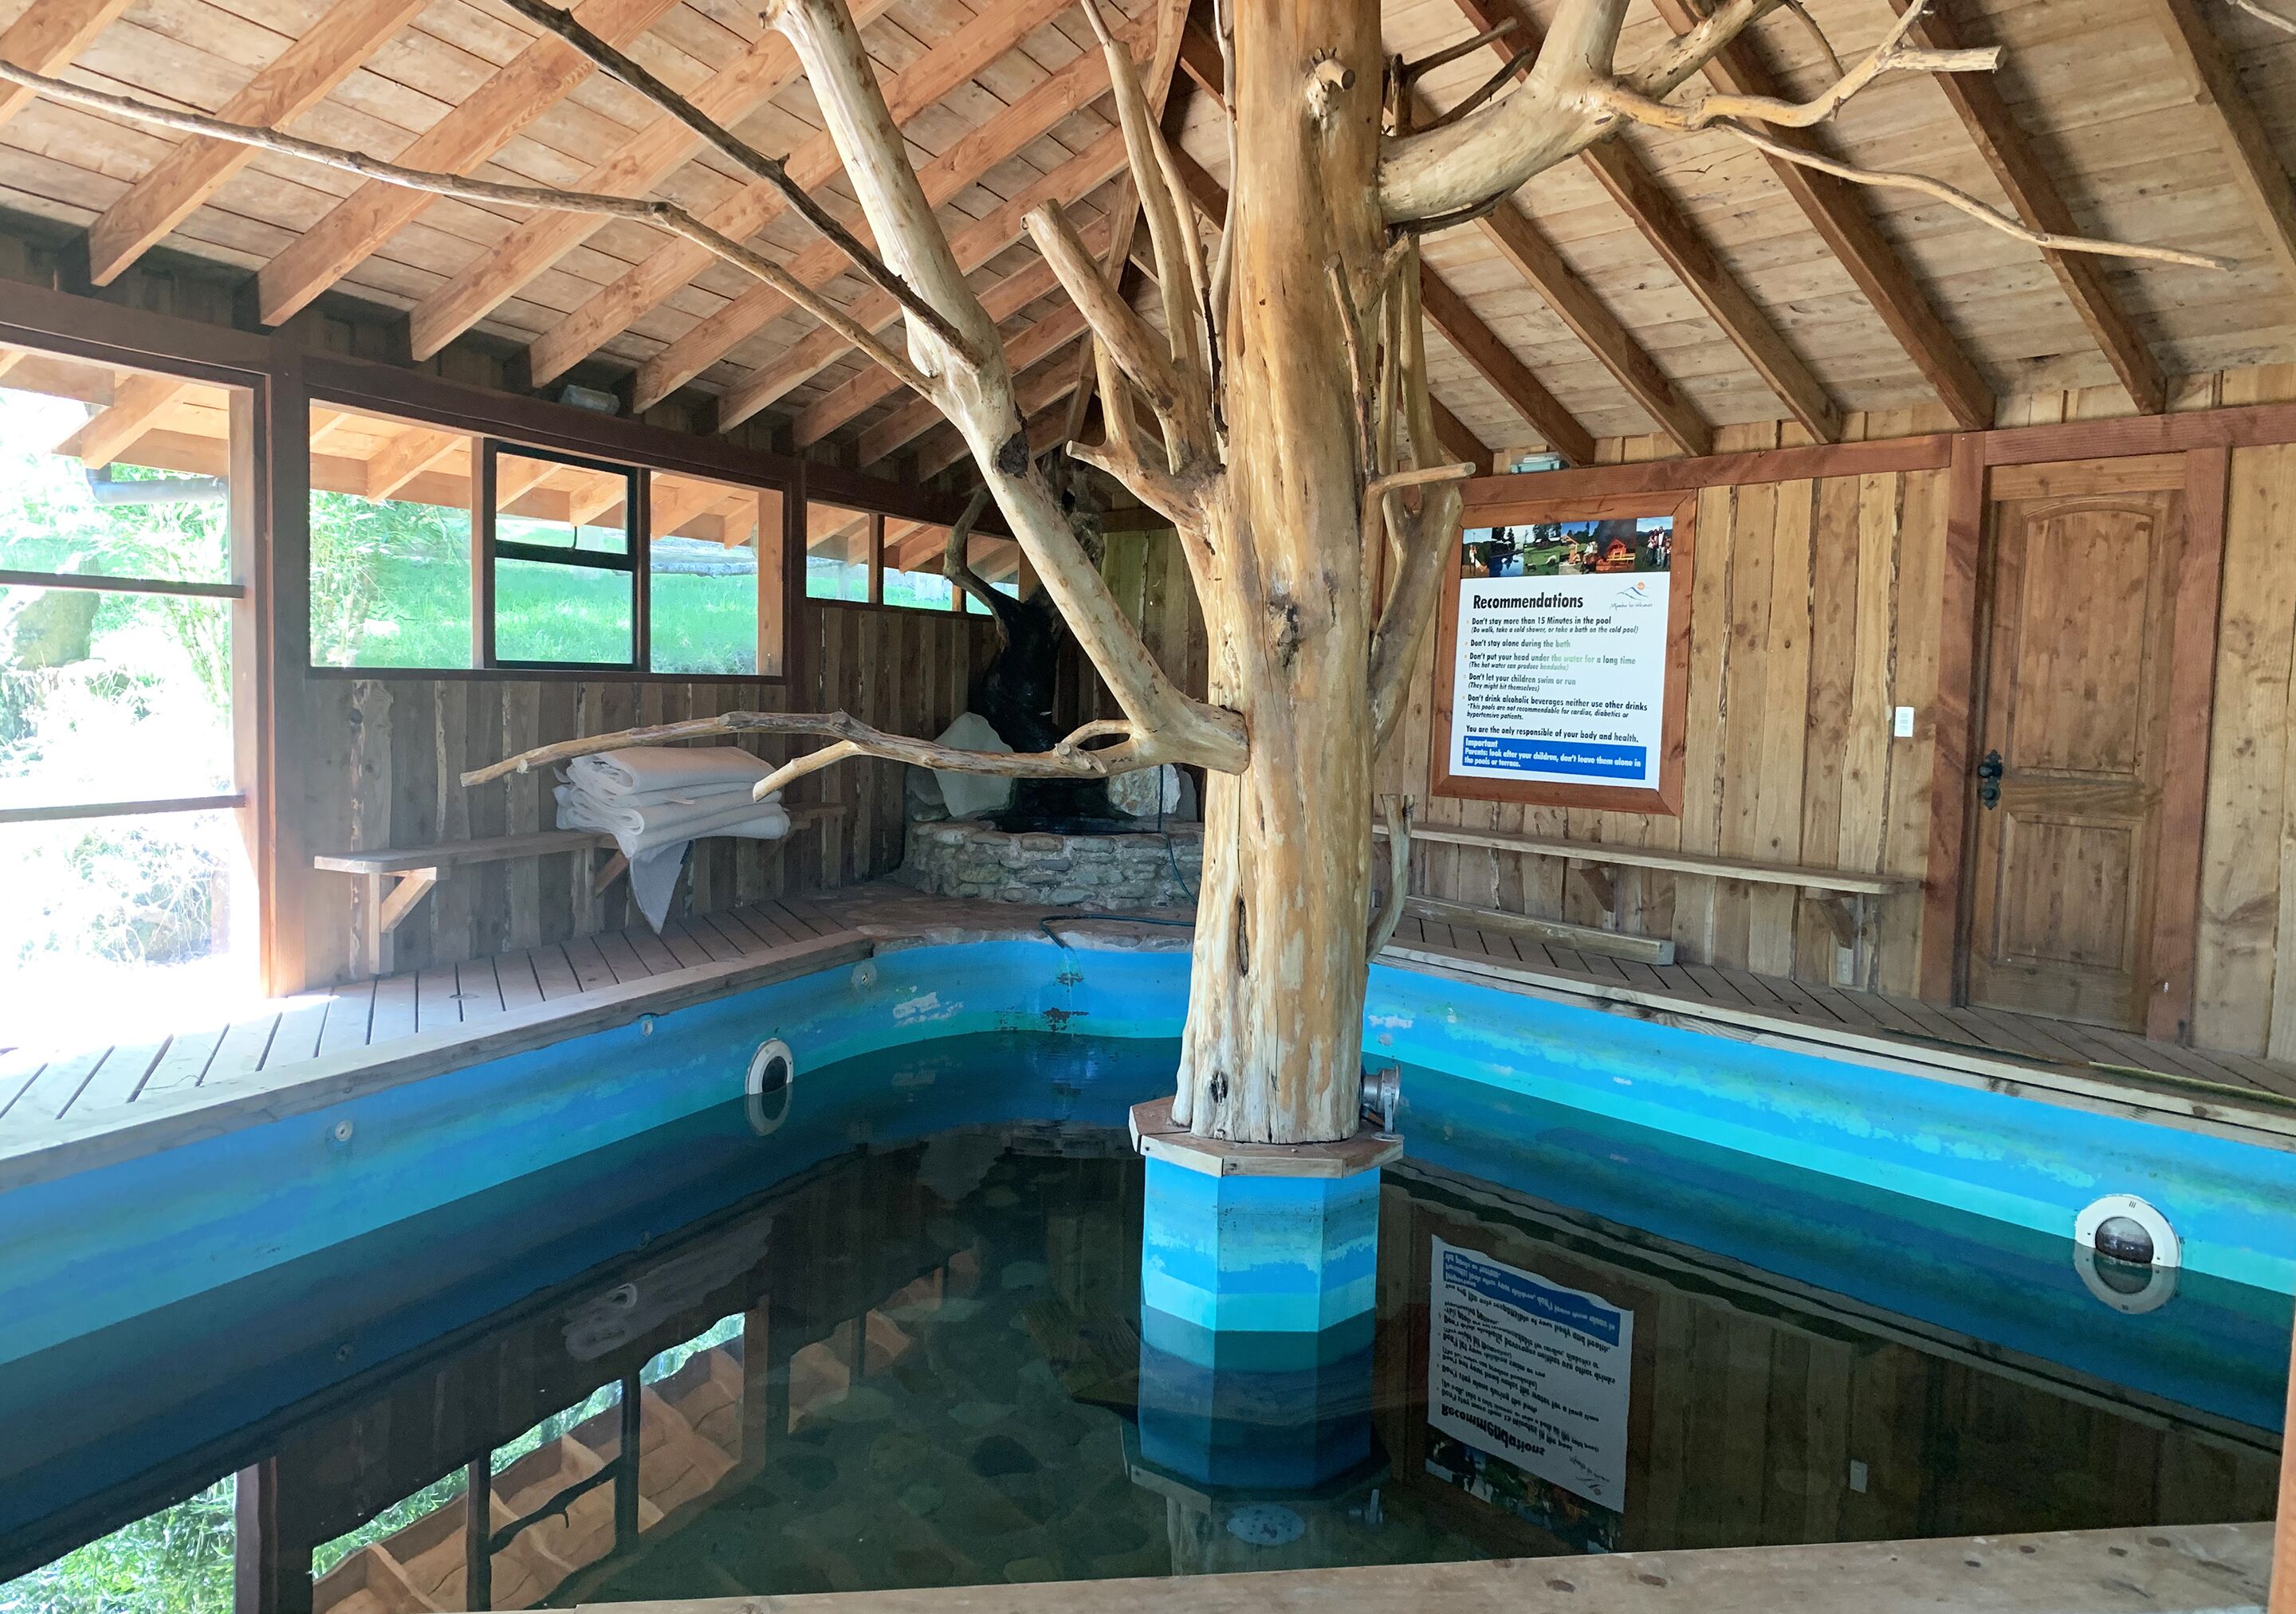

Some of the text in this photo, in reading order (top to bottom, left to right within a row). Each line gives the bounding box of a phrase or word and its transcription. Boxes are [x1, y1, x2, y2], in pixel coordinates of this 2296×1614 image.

[1473, 592, 1583, 609] Recommendations
[1596, 616, 1611, 626] pool
[1622, 626, 1638, 634] pool)
[1521, 638, 1541, 649] during
[1514, 653, 1529, 662] head
[1551, 654, 1561, 662] the
[1585, 654, 1595, 663] for
[1602, 655, 1618, 666] long
[1620, 655, 1636, 665] time
[1508, 683, 1540, 693] themselves)
[1502, 695, 1529, 704] alcoholic
[1531, 697, 1563, 707] beverages
[1566, 698, 1590, 707] neither
[1605, 701, 1623, 709] other
[1626, 701, 1647, 711] drinks
[1571, 708, 1592, 717] cardiac,
[1516, 728, 1553, 736] responsible
[1580, 730, 1597, 740] body
[1614, 732, 1639, 743] health.
[1465, 738, 1498, 748] Important
[1504, 749, 1517, 758] after
[1533, 752, 1559, 762] children,
[1560, 753, 1577, 762] don't
[1578, 755, 1595, 764] leave
[1596, 756, 1614, 765] them
[1614, 757, 1633, 767] alone
